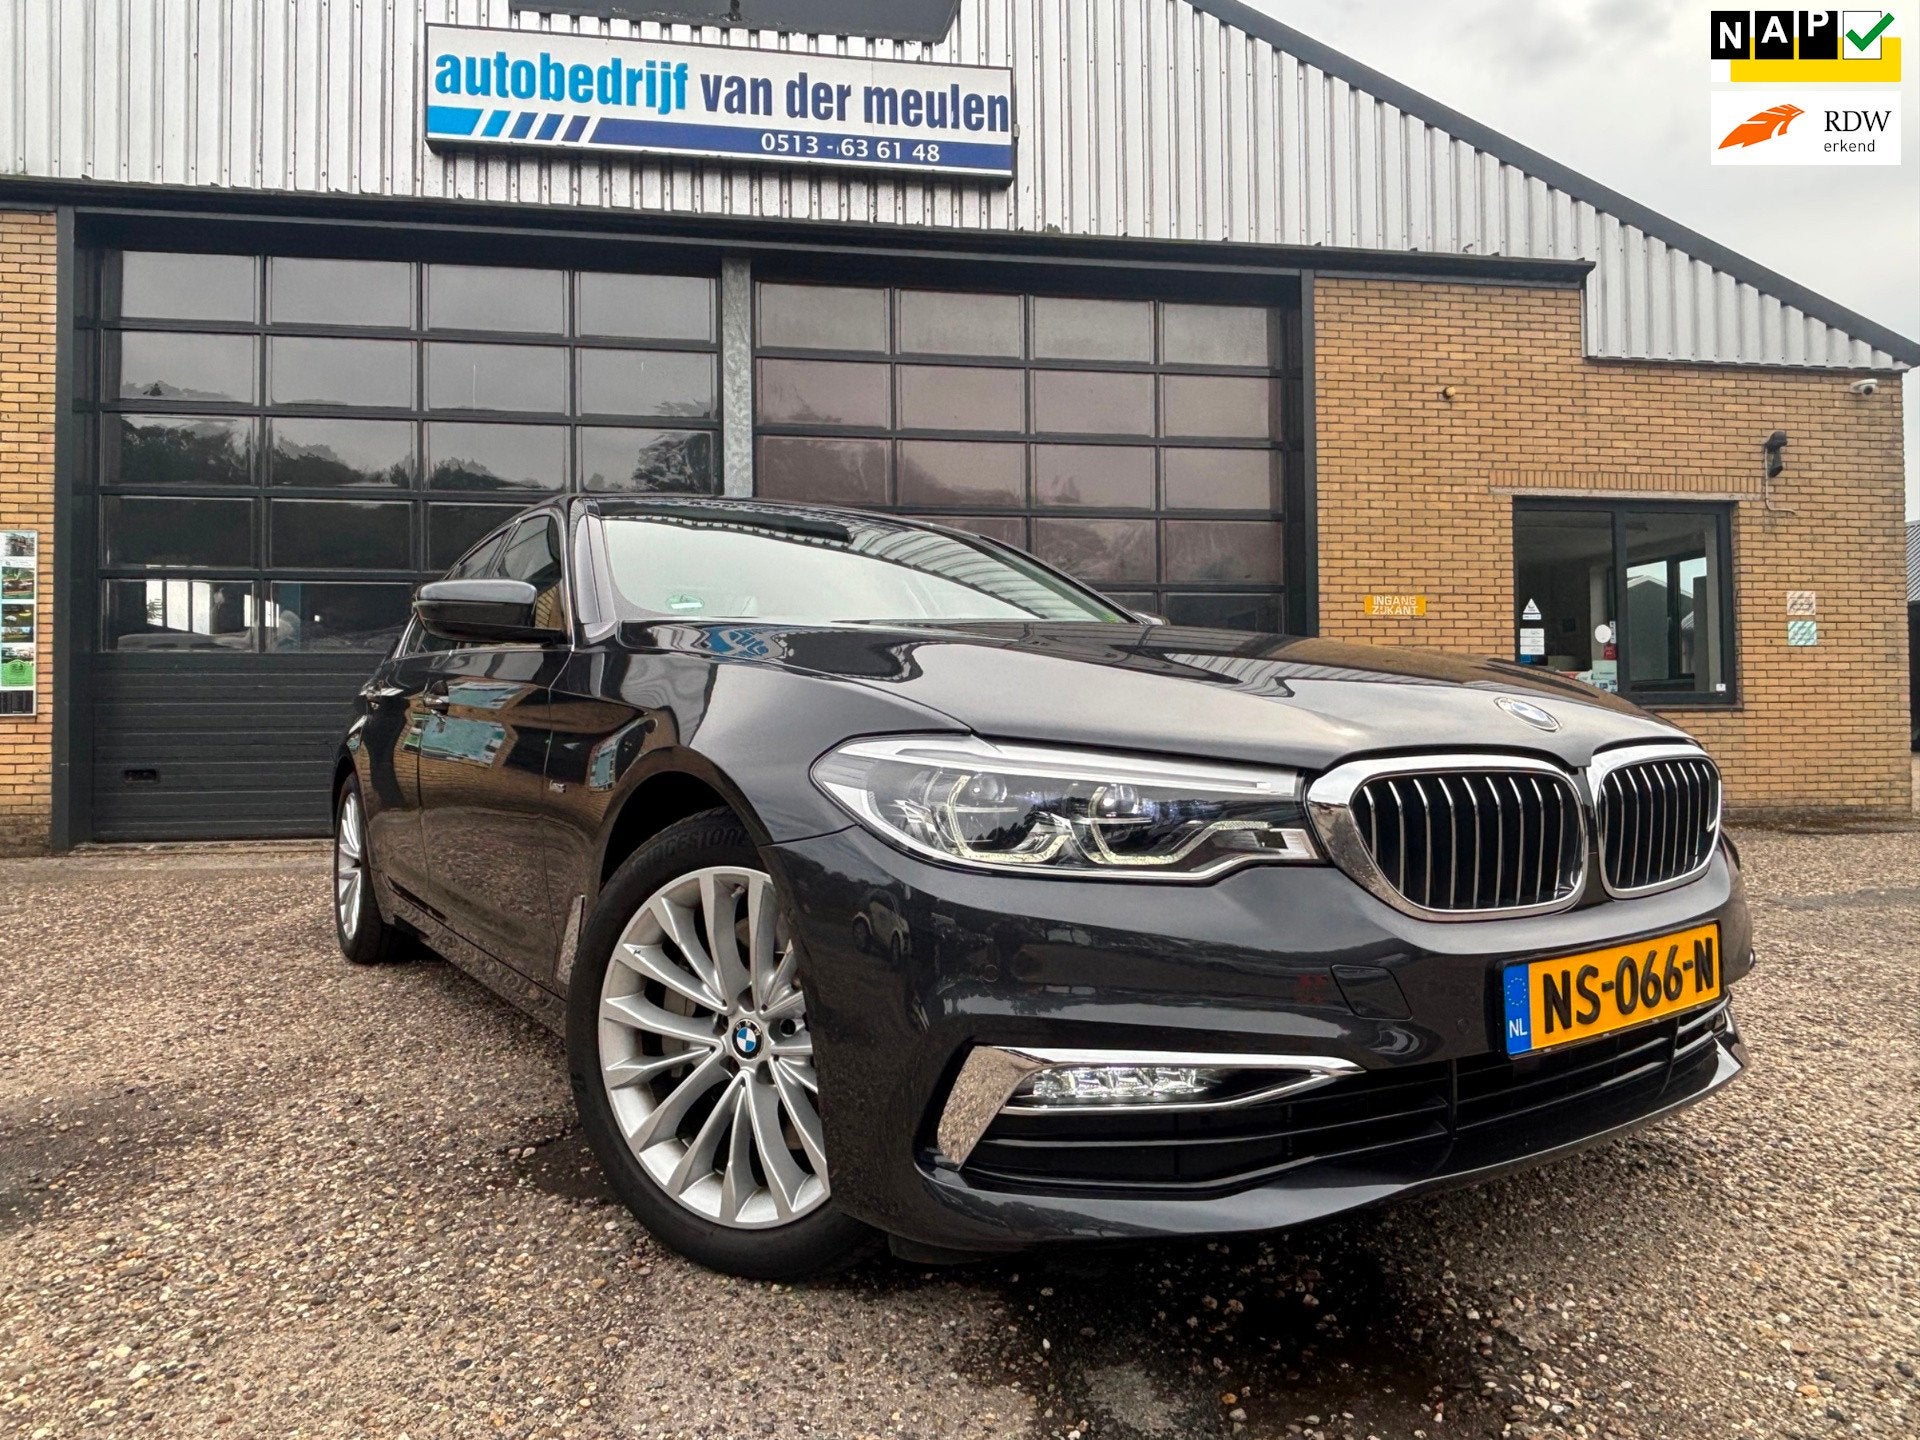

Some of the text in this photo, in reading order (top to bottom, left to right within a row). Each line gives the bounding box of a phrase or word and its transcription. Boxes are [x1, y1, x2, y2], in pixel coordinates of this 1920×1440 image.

[435, 51, 1009, 133] autobedrijf van der meulen
[760, 132, 819, 155] 0513
[840, 138, 869, 158] 63
[876, 141, 901, 160] 61
[912, 144, 940, 162] 48
[1373, 594, 1417, 606] INGANG
[1542, 937, 1714, 1034] NS-066-N
[1508, 1017, 1528, 1039] NL
